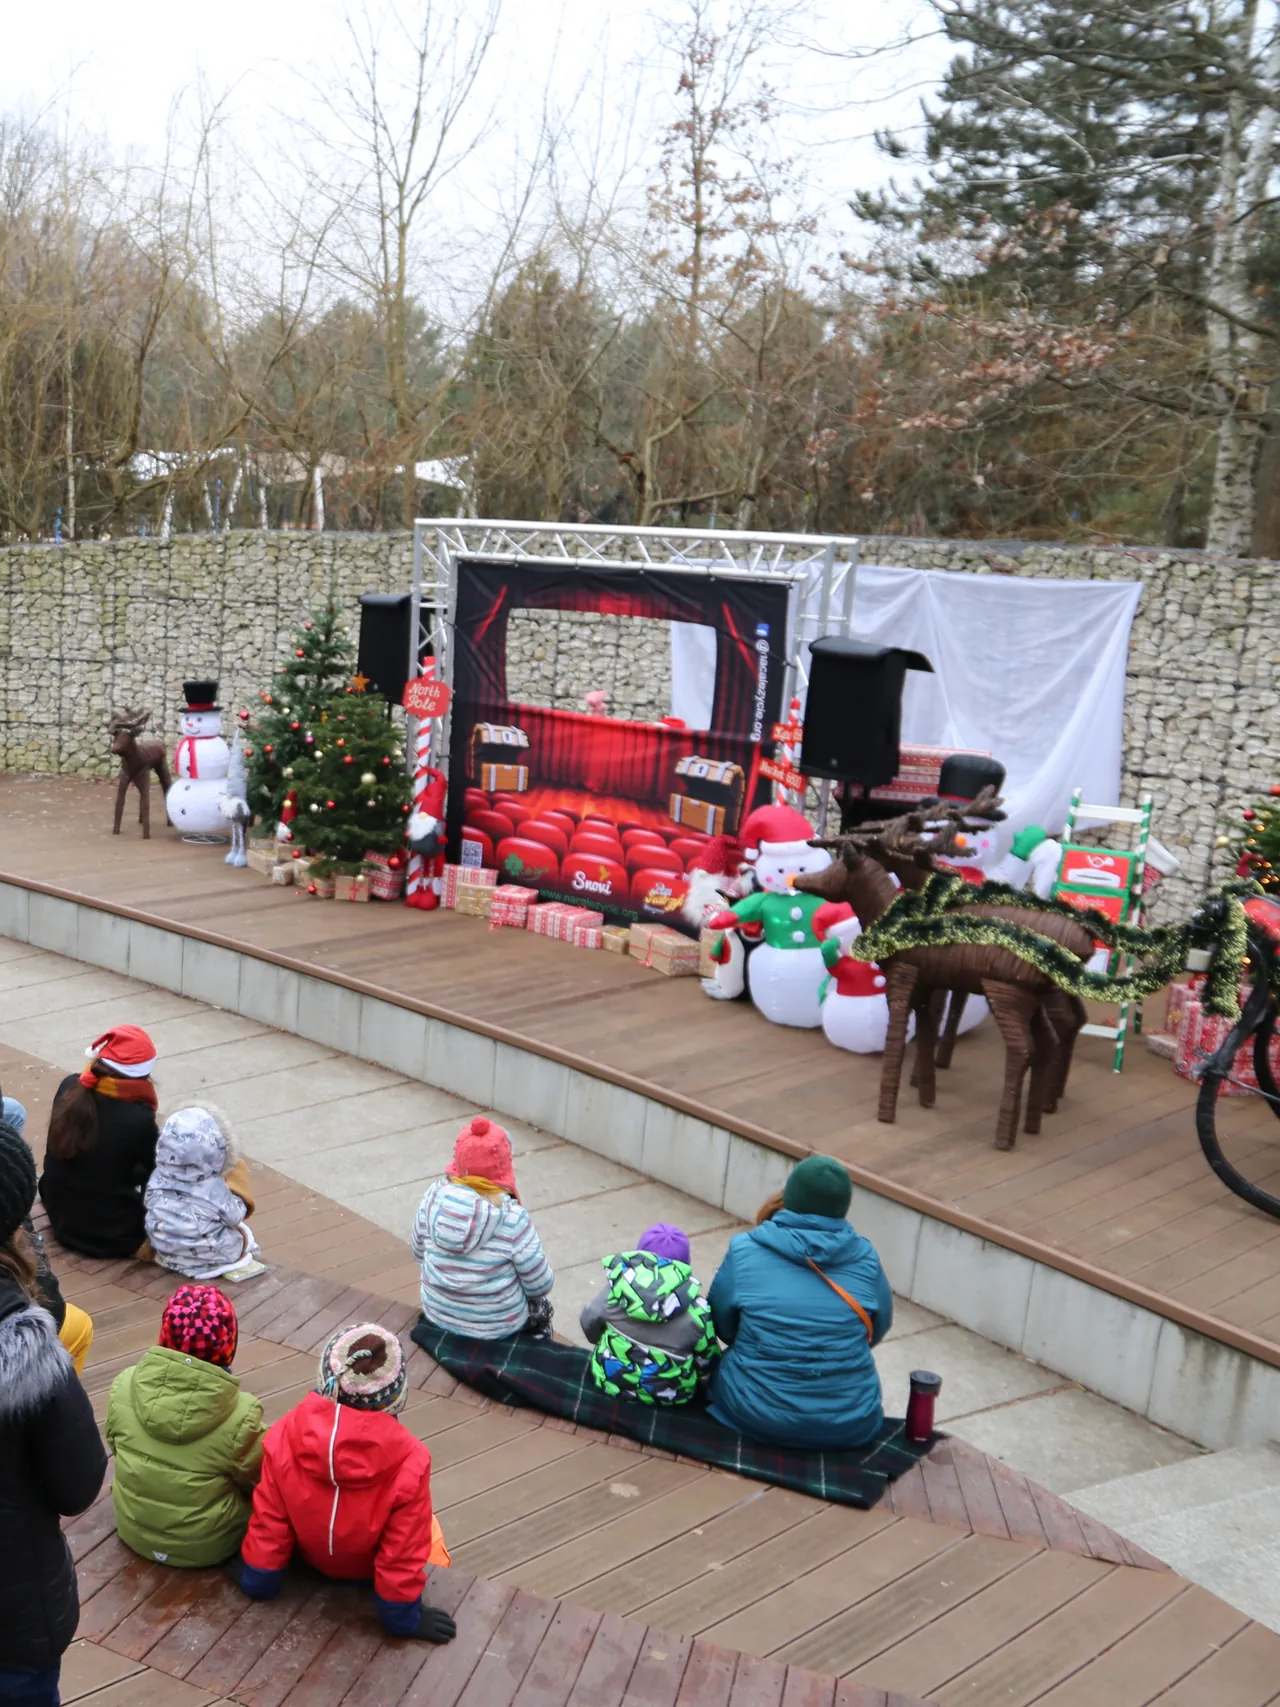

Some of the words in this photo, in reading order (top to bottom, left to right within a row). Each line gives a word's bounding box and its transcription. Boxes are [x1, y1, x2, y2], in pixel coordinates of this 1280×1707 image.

[408, 682, 441, 699] North
[407, 694, 437, 711] Pole
[572, 870, 613, 896] Snovi
